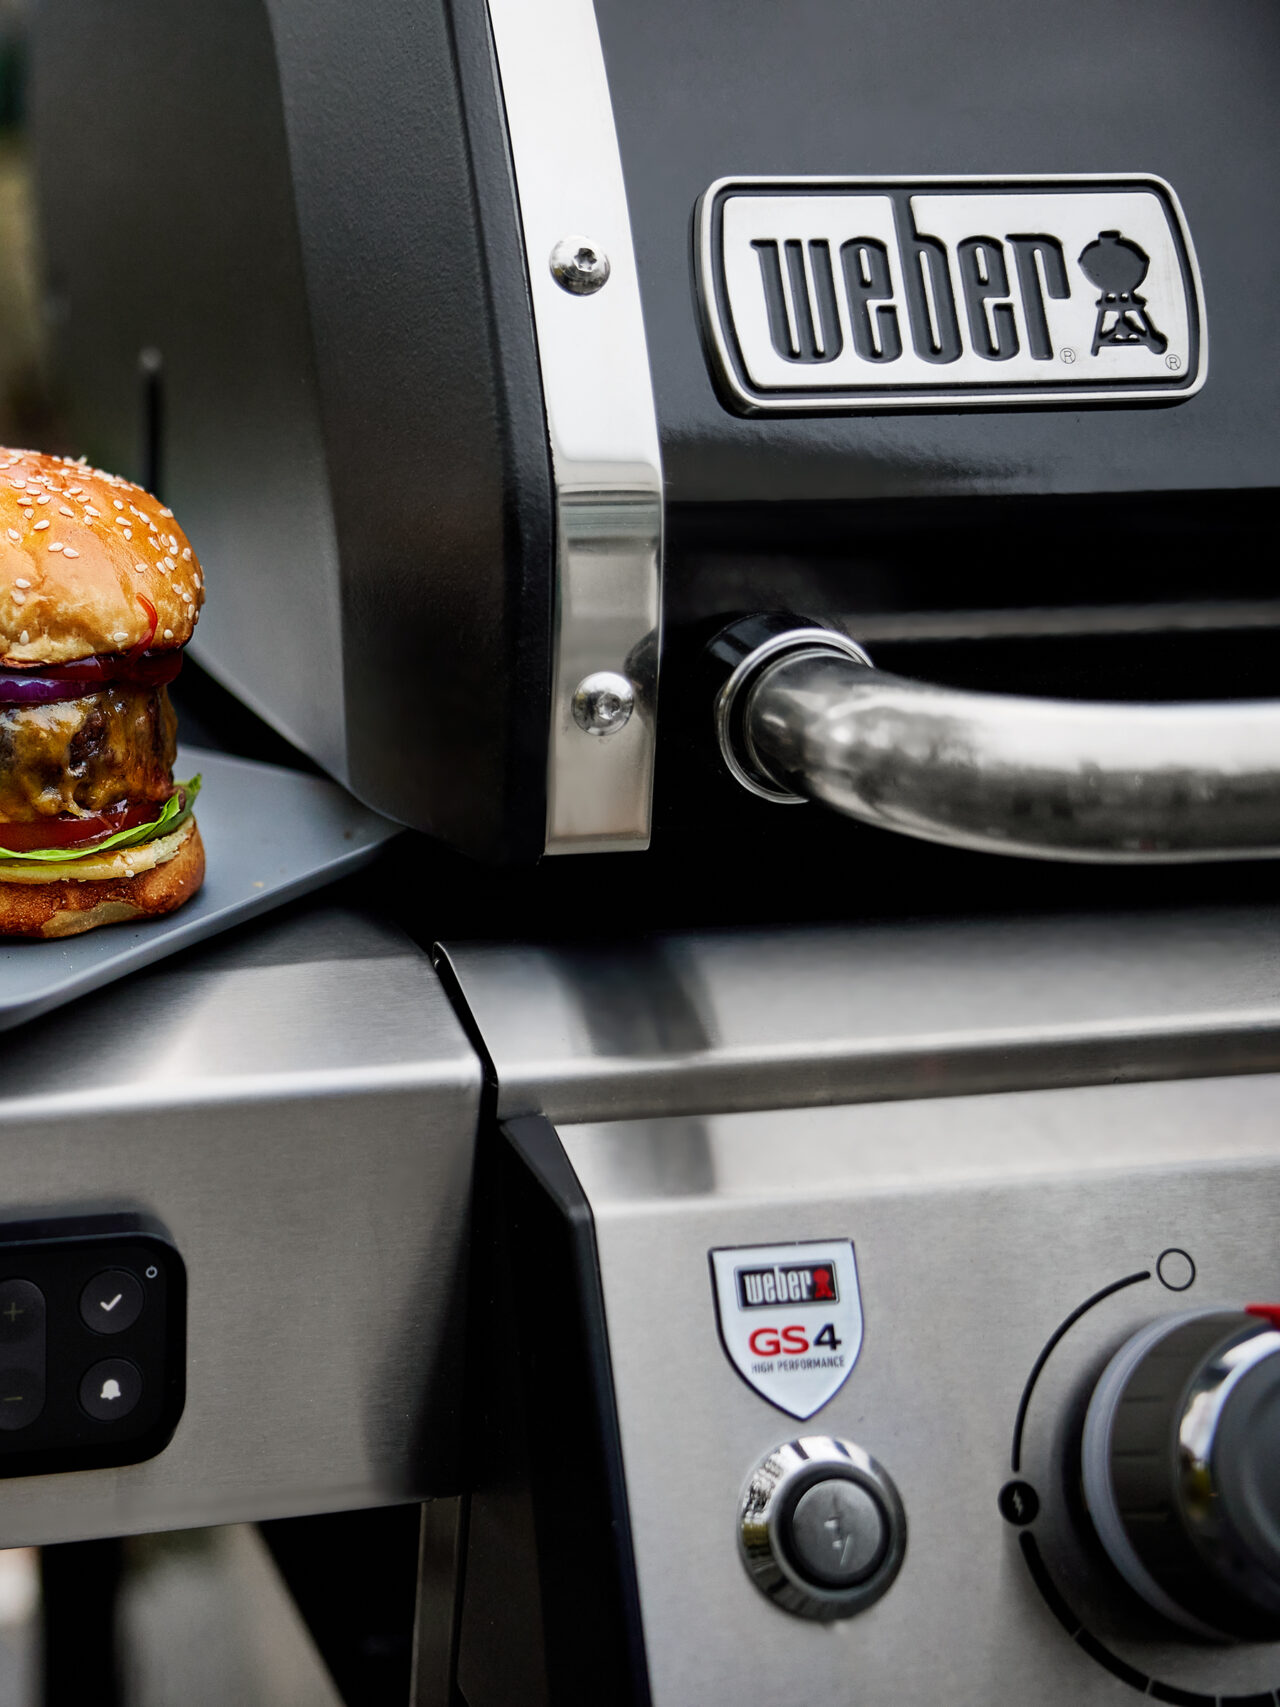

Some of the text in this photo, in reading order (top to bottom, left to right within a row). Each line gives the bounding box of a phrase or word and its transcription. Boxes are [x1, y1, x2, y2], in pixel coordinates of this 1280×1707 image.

[750, 196, 1071, 364] weber
[743, 1265, 812, 1303] weber
[748, 1323, 842, 1357] GS4
[752, 1356, 845, 1373] HIGH PERFORMANCE
